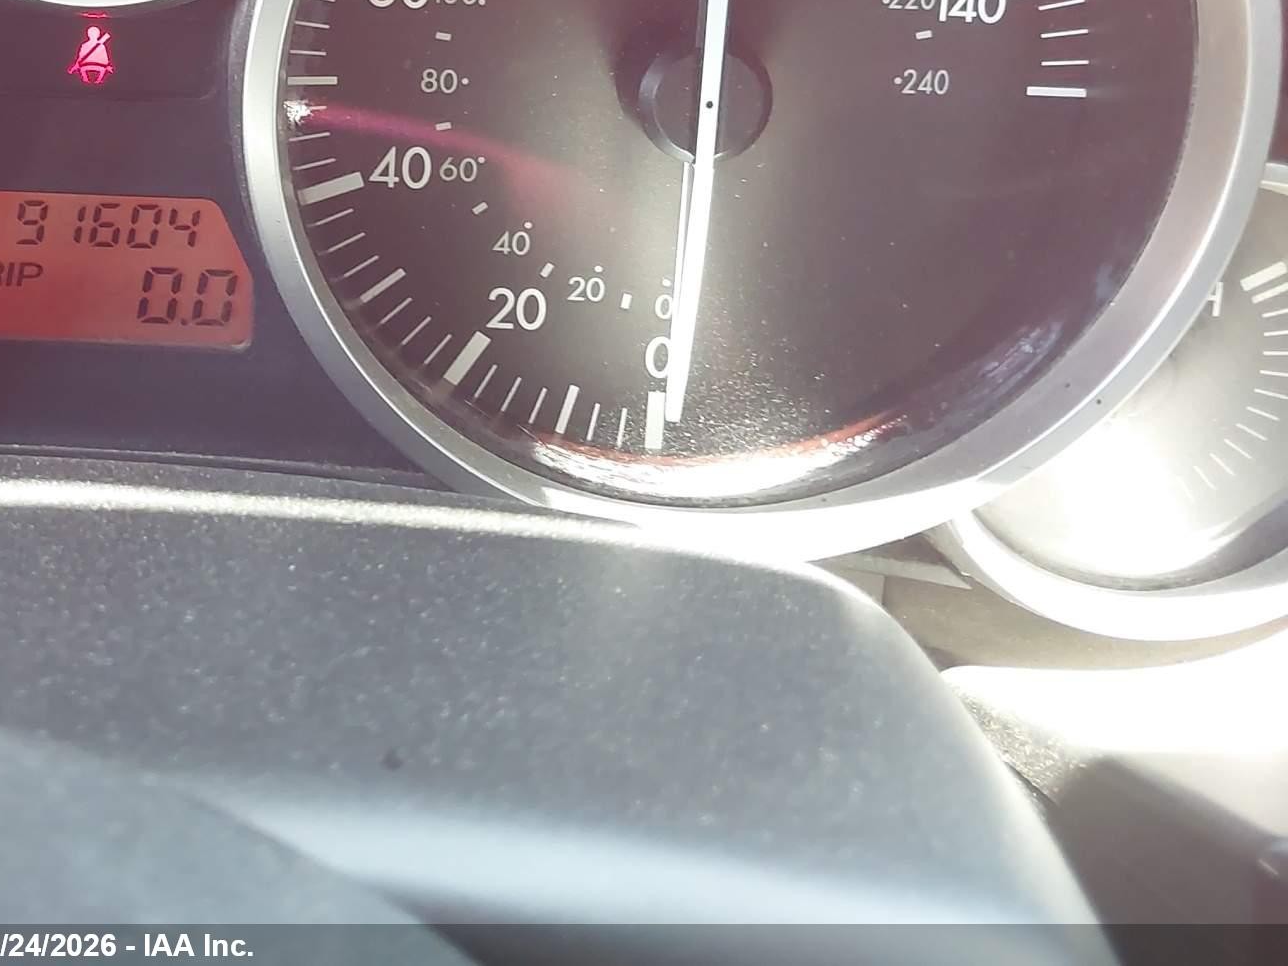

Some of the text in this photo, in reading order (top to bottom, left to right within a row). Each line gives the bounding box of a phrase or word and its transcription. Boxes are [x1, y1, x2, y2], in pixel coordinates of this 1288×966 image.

[420, 68, 458, 94] 80
[901, 69, 949, 96] 240
[368, 145, 432, 189] 40
[438, 156, 478, 183] 60
[15, 199, 202, 250] 91604
[492, 231, 531, 256] 40
[136, 266, 239, 327] 0.0
[567, 276, 606, 304] 20
[485, 286, 548, 331] 20
[654, 293, 674, 321] 0
[644, 336, 672, 380] 0
